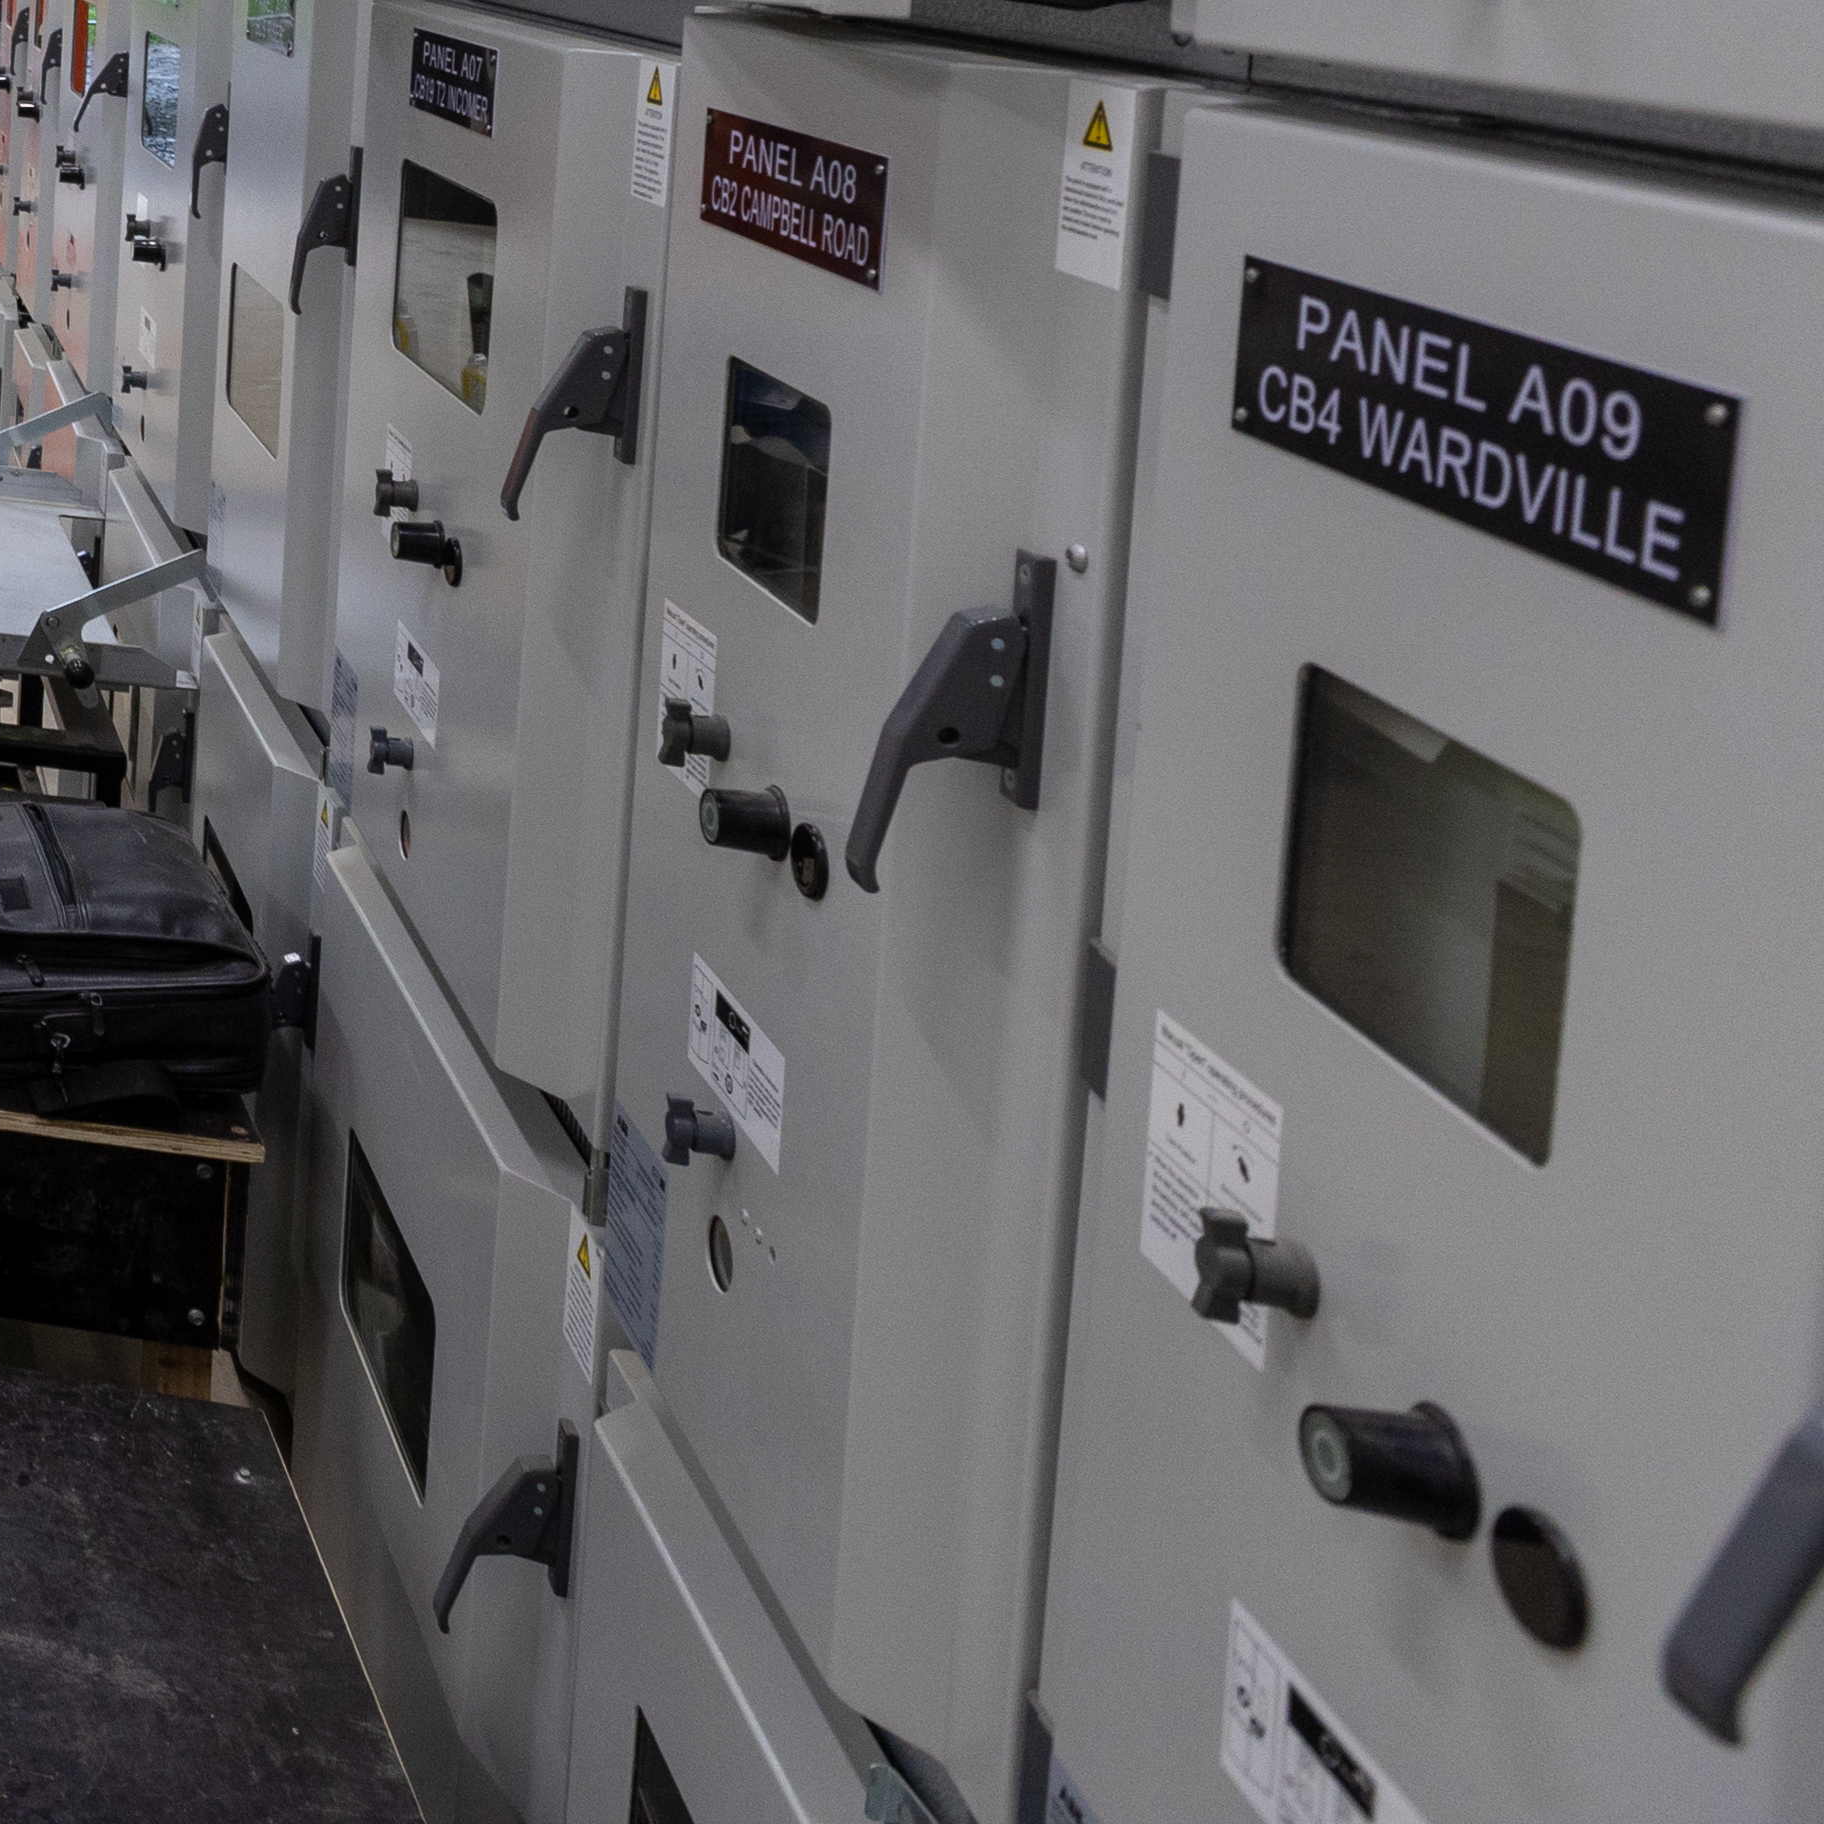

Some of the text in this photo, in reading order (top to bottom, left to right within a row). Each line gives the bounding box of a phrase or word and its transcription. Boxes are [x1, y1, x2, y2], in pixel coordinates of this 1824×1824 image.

[414, 73, 488, 124] CB19 T2 INCOMER
[423, 41, 483, 82] PANEL A07
[729, 129, 802, 187] PANEL
[809, 155, 857, 204] A08
[711, 175, 869, 266] CB2 CAMPBELL ROAD
[1297, 295, 1643, 461] PANEL A09
[1258, 365, 1686, 582] CB4 WARDVILLE
